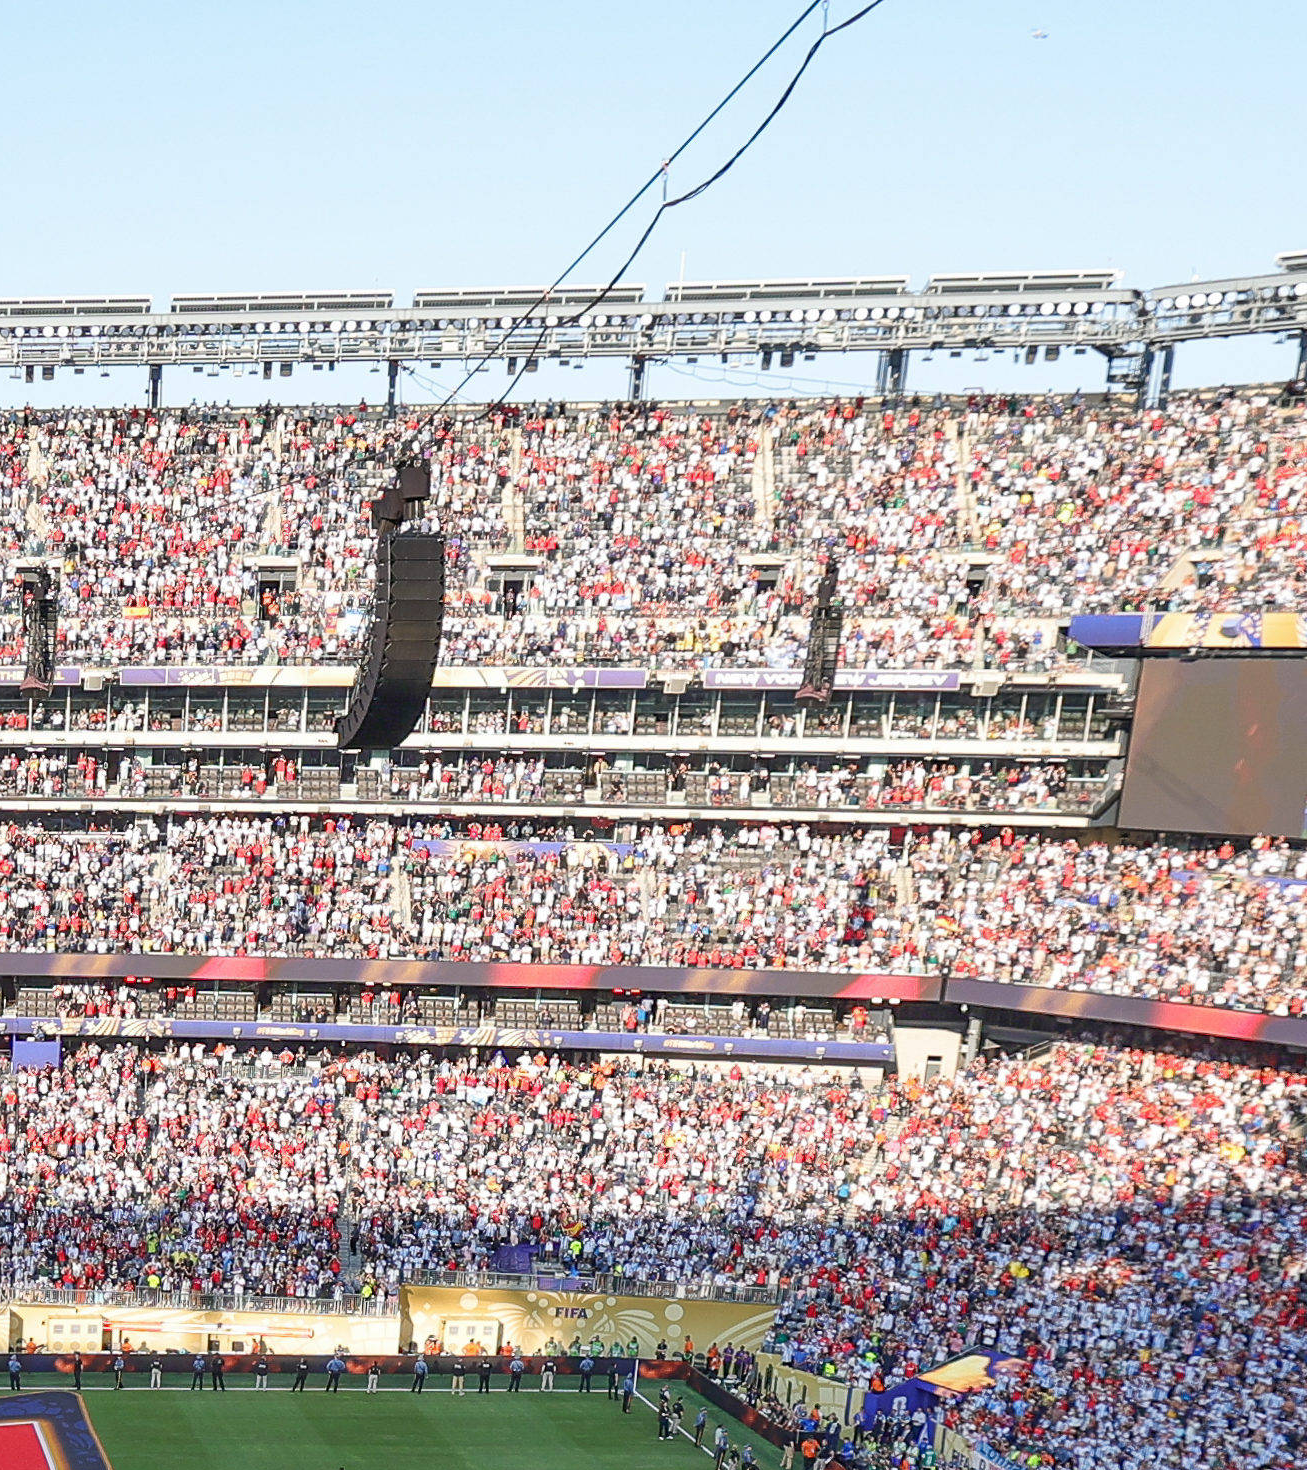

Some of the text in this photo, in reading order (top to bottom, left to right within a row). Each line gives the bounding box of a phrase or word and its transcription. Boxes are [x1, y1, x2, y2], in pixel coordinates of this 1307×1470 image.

[715, 674, 760, 685] NEW
[764, 674, 804, 685] YOR
[870, 675, 948, 686] JERSEY
[555, 1306, 587, 1319] FIFA
